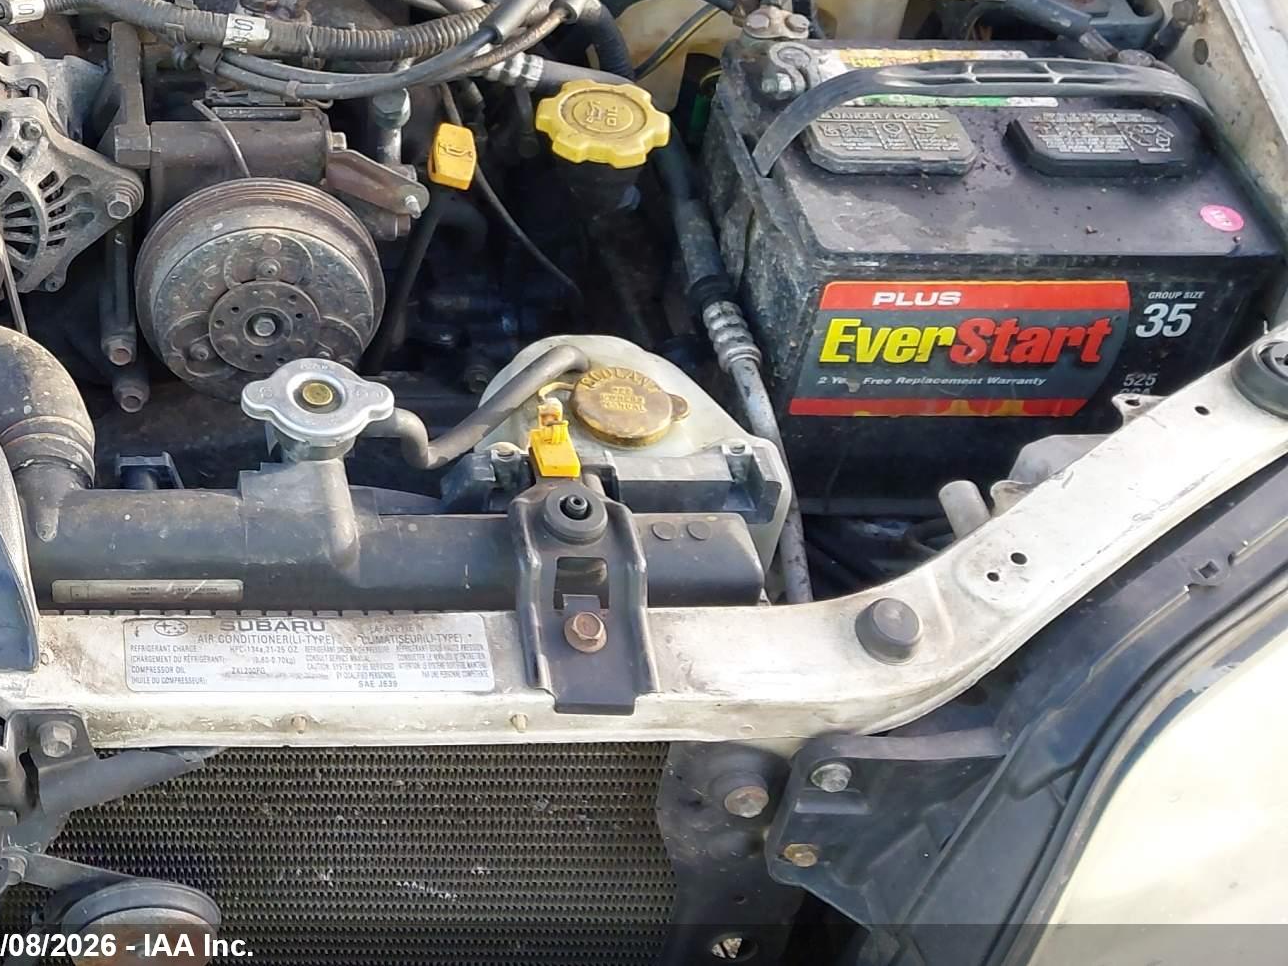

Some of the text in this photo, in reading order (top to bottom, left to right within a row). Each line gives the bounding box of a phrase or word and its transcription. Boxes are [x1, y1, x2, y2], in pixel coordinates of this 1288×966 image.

[606, 105, 618, 127] OIL
[872, 291, 962, 306] PLUS
[1148, 291, 1206, 300] GROUP SIZE
[1135, 302, 1198, 338] 35
[819, 317, 1112, 365] EverStart
[817, 376, 826, 384] 2
[863, 377, 891, 385] Free
[895, 376, 982, 386] Replacement
[987, 376, 1047, 386] Warranty
[1123, 373, 1159, 387] 525
[220, 619, 326, 632] SUBARU
[198, 634, 214, 644] AIR
[130, 645, 171, 653] REFRIGERANT
[131, 666, 173, 674] COMPRESSOR
[358, 680, 375, 688] SAE
